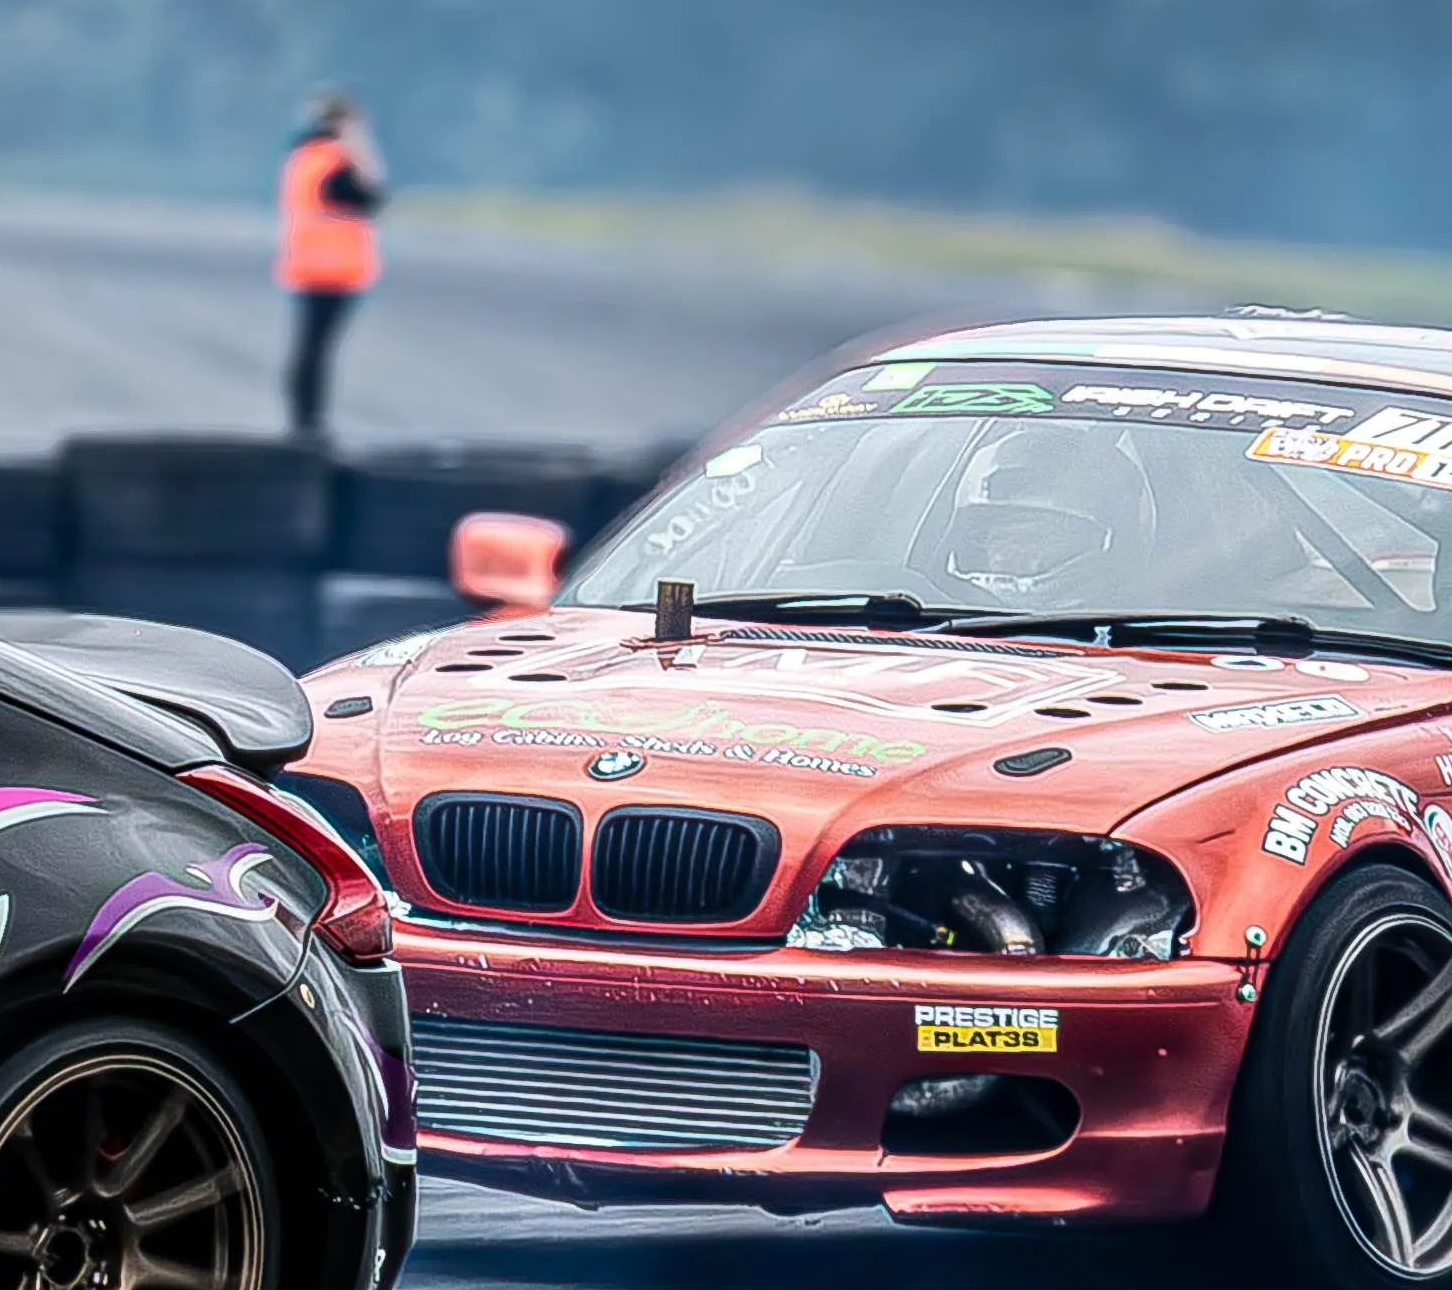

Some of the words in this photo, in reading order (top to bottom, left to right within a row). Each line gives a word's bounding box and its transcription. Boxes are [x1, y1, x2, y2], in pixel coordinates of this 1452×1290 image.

[1338, 445, 1419, 475] PRO
[1285, 766, 1425, 826] CONCRETE
[1262, 803, 1318, 866] BM
[914, 1005, 1059, 1028] PRESTIGE
